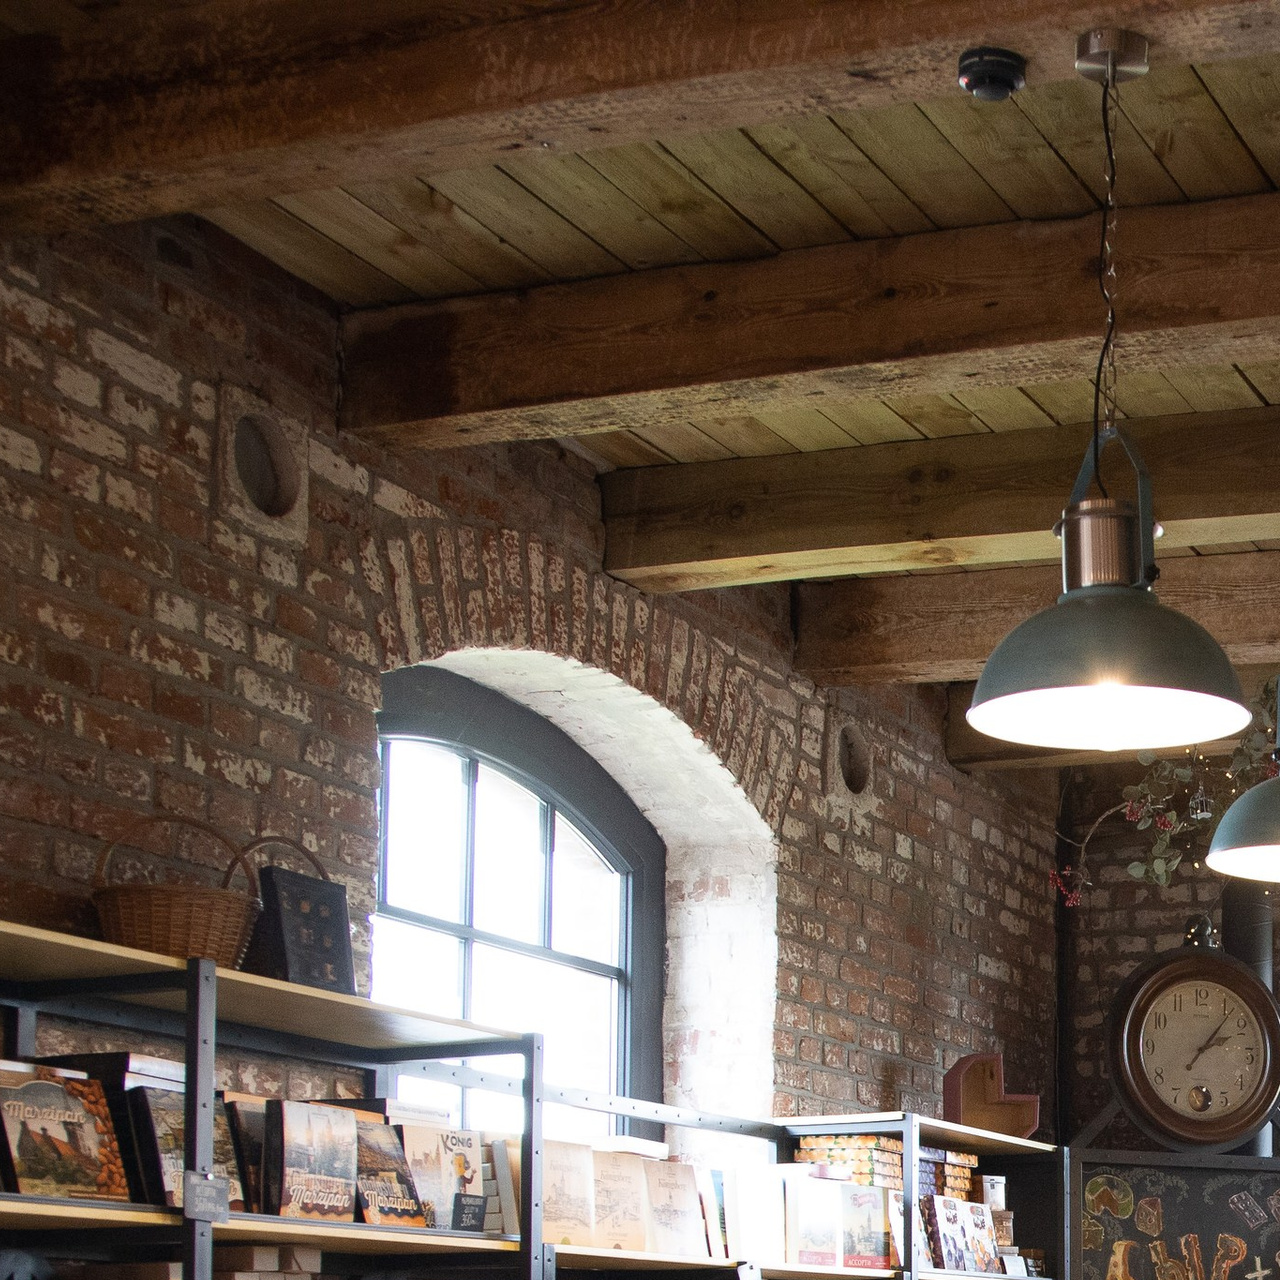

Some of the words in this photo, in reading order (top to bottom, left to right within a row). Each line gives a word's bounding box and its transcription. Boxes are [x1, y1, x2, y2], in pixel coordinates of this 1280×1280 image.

[1173, 993, 1183, 1012] 11
[1195, 988, 1209, 1007] 12
[1221, 998, 1228, 1016] 1
[1154, 1011, 1167, 1030] 10
[1236, 1017, 1247, 1036] 2
[1145, 1039, 1155, 1056] 9
[1244, 1047, 1255, 1065] 3
[1154, 1067, 1164, 1085] 8
[1233, 1074, 1246, 1091] 4
[1171, 1087, 1181, 1104] 7
[1219, 1091, 1229, 1107] 5
[3, 1100, 86, 1123] Marzipan
[440, 1131, 473, 1156] KÖNIG
[289, 1184, 351, 1210] Marzipan
[364, 1190, 418, 1213] Marzipan
